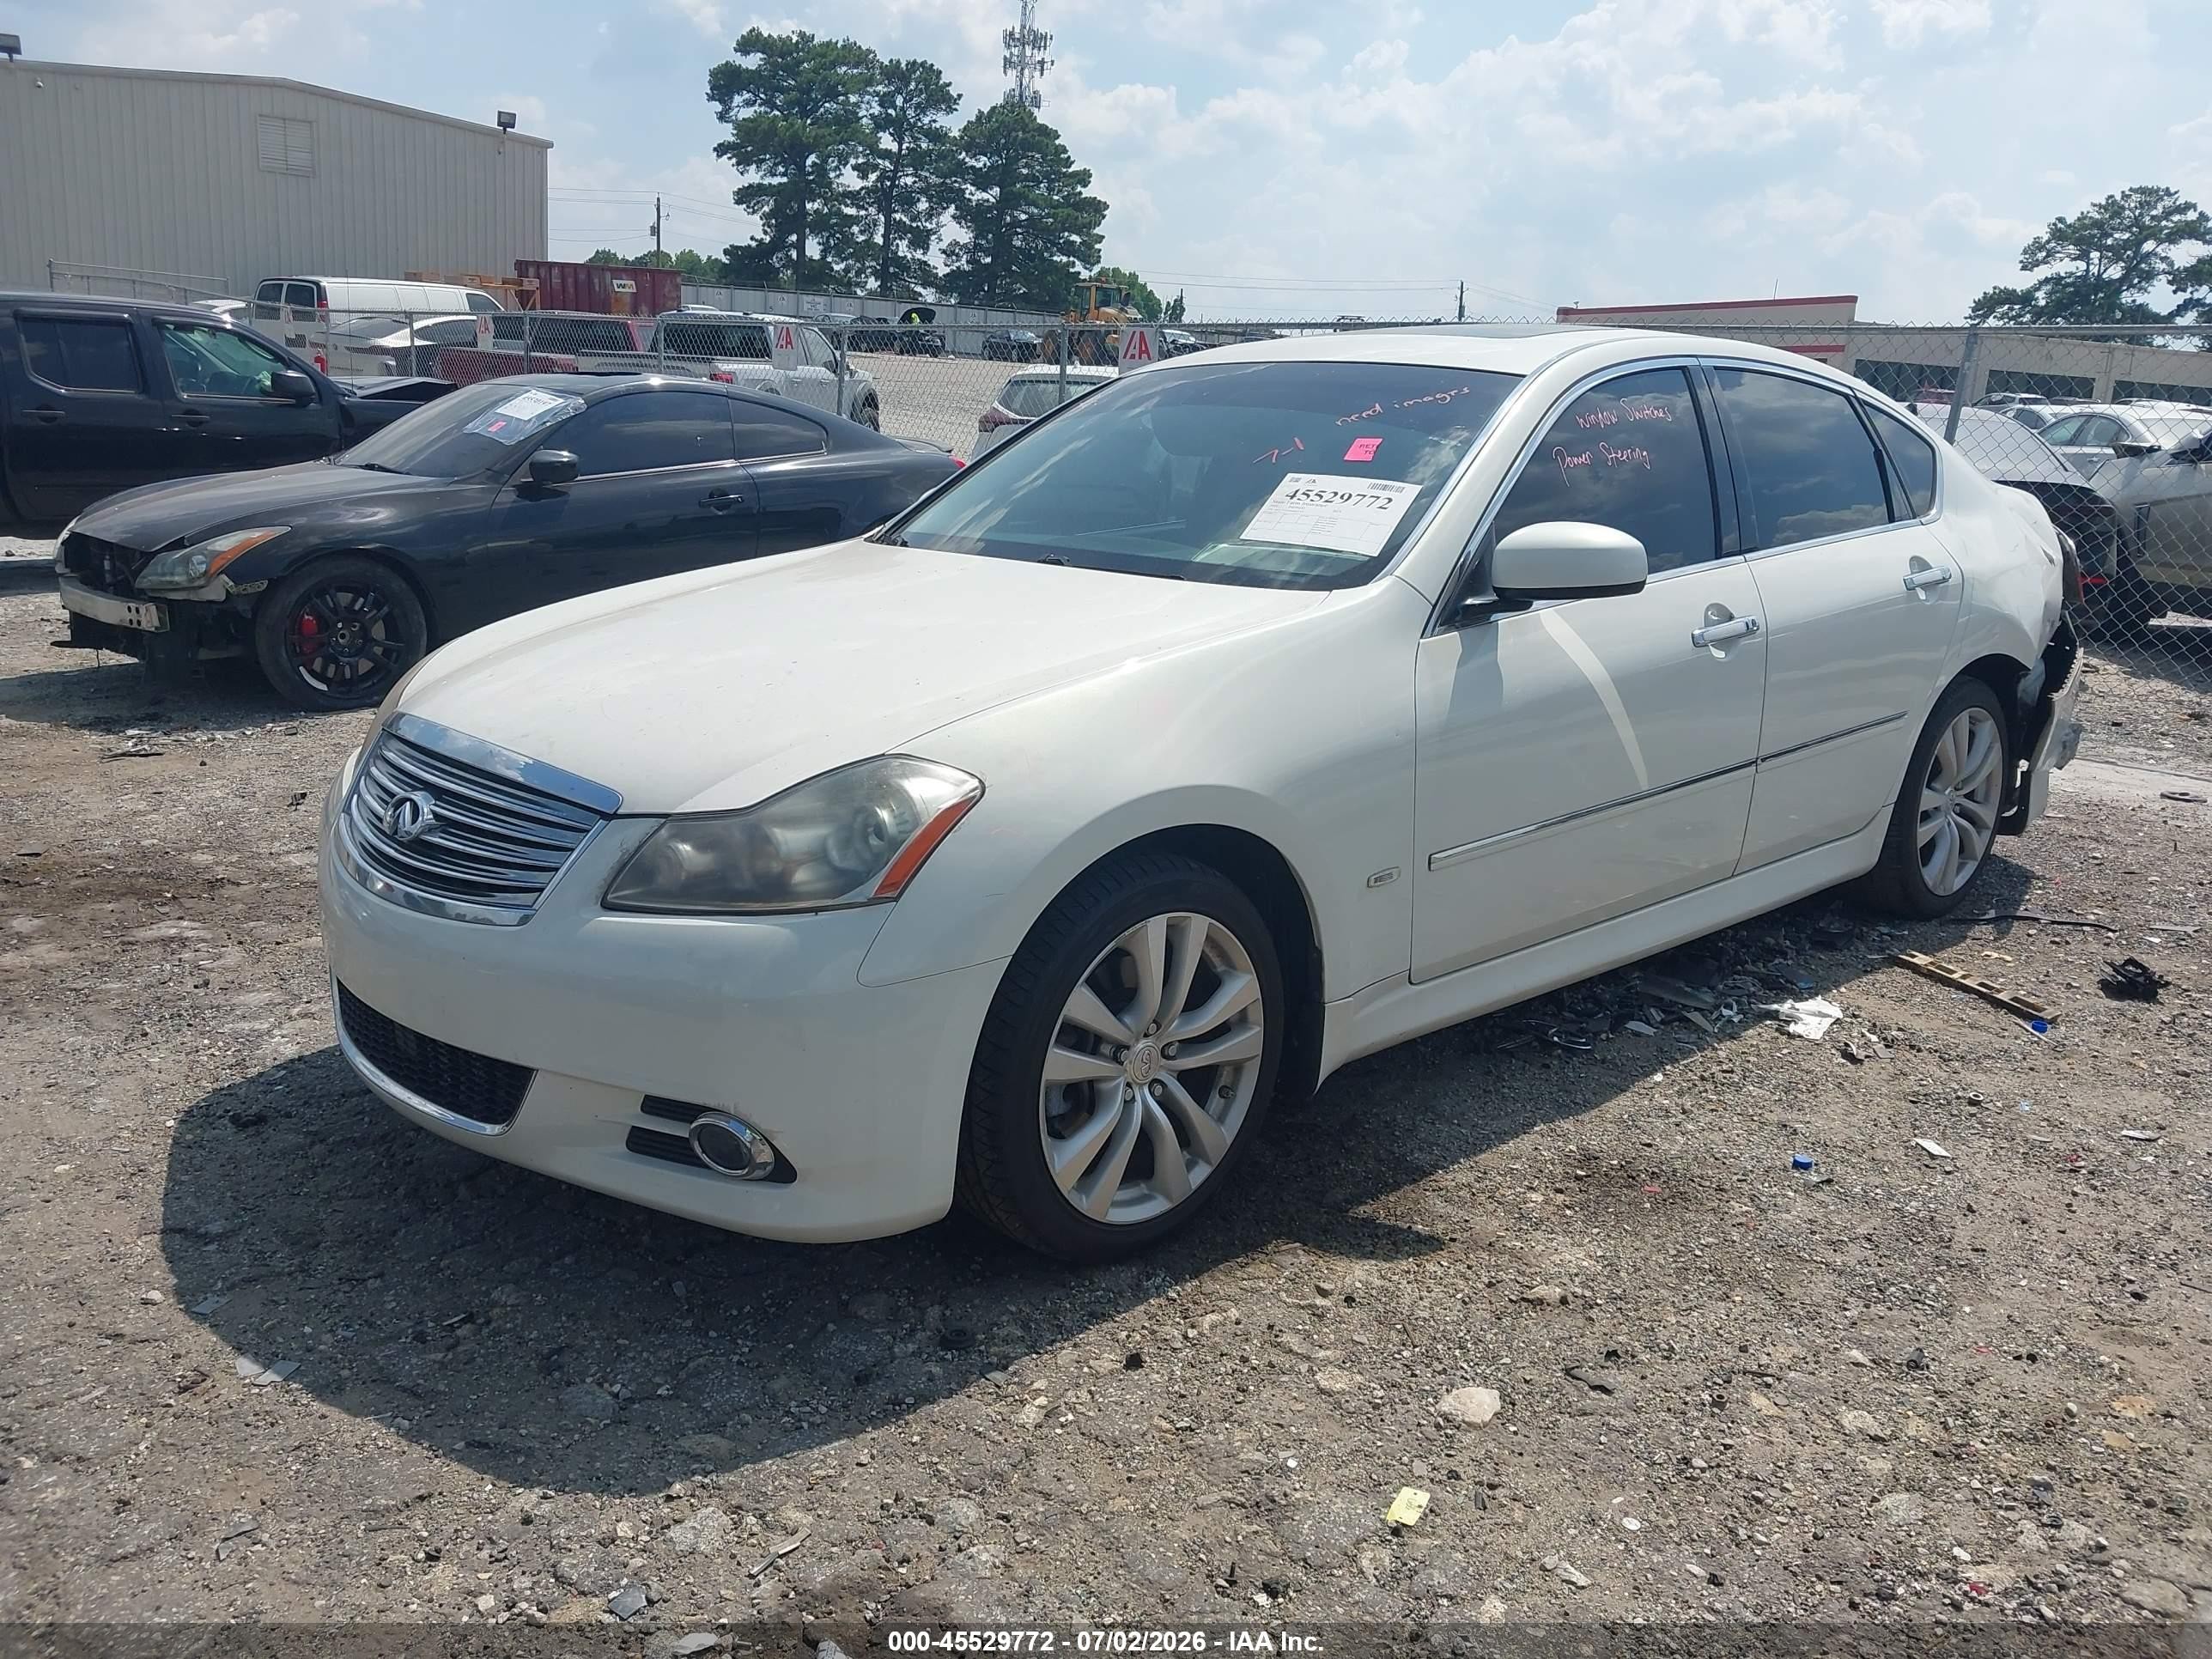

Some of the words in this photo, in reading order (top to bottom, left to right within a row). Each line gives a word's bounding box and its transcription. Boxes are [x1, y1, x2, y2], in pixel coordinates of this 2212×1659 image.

[1335, 403, 1383, 426] need
[1553, 446, 1593, 487] Power
[1599, 441, 1650, 470] Steering
[1285, 488, 1394, 510] 45529772
